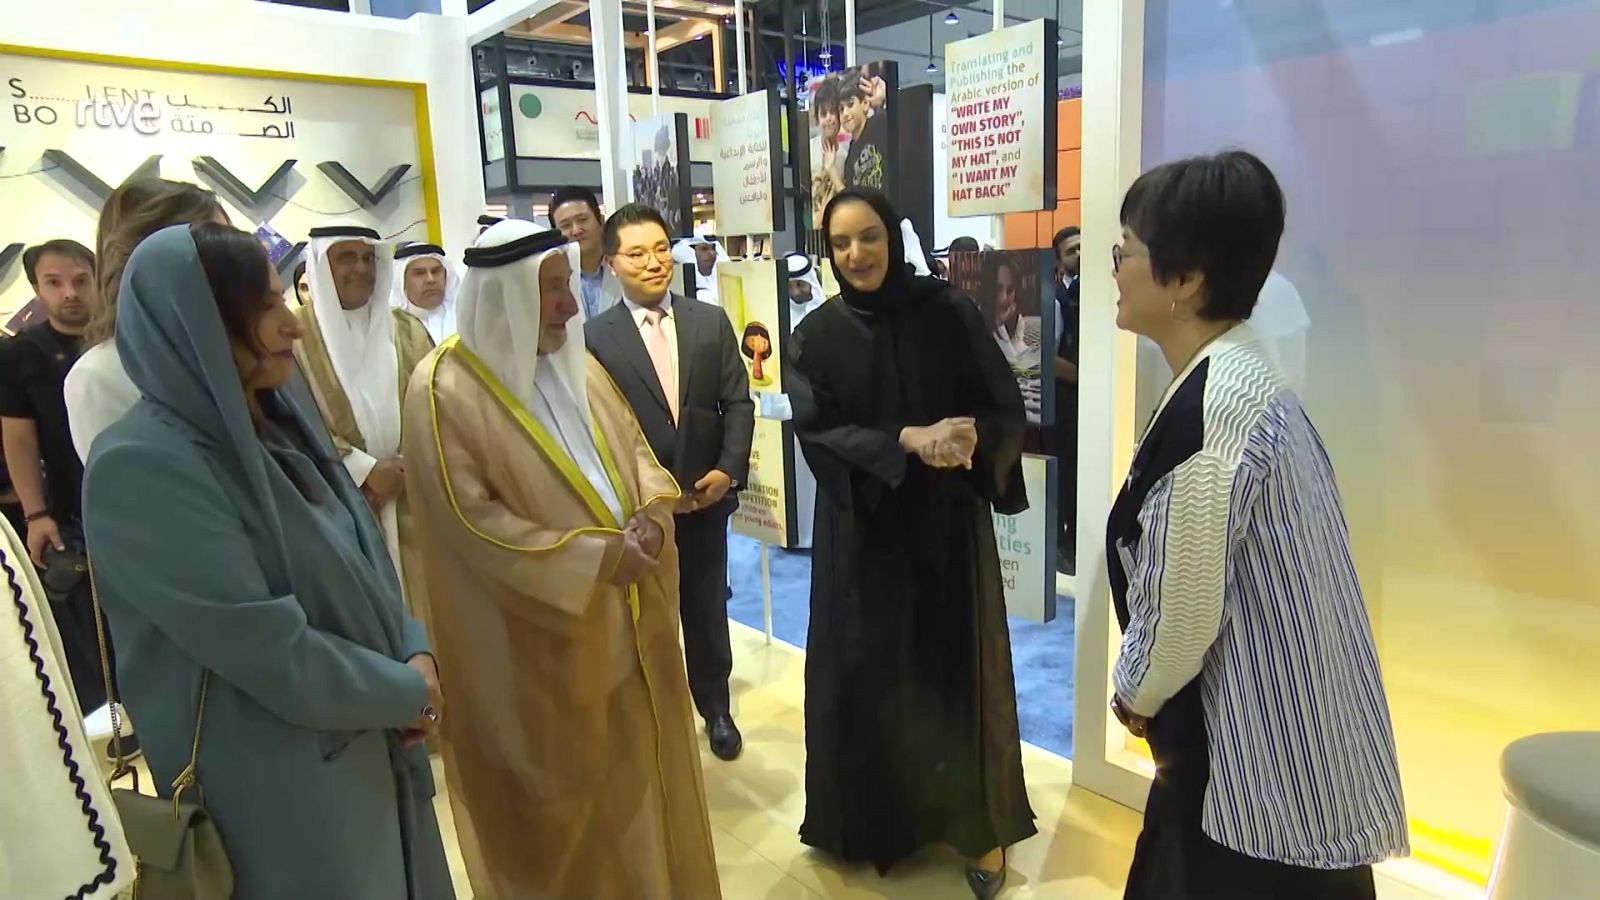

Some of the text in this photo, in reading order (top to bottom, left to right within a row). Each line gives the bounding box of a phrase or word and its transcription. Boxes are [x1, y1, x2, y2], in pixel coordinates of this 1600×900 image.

[951, 42, 1033, 75] Translating and
[951, 61, 1025, 88] Publishing the
[951, 73, 1039, 103] Arabic version of
[993, 97, 1011, 112] MY
[951, 121, 977, 137] OWN
[984, 134, 995, 148] IS
[997, 129, 1021, 146] NOT
[952, 155, 969, 169] MY
[1002, 148, 1021, 162] and
[966, 167, 998, 184] WANT
[1000, 165, 1018, 179] MY
[952, 187, 974, 202] HAT
[748, 482, 779, 498] TRATION
[998, 534, 1032, 555] ties
